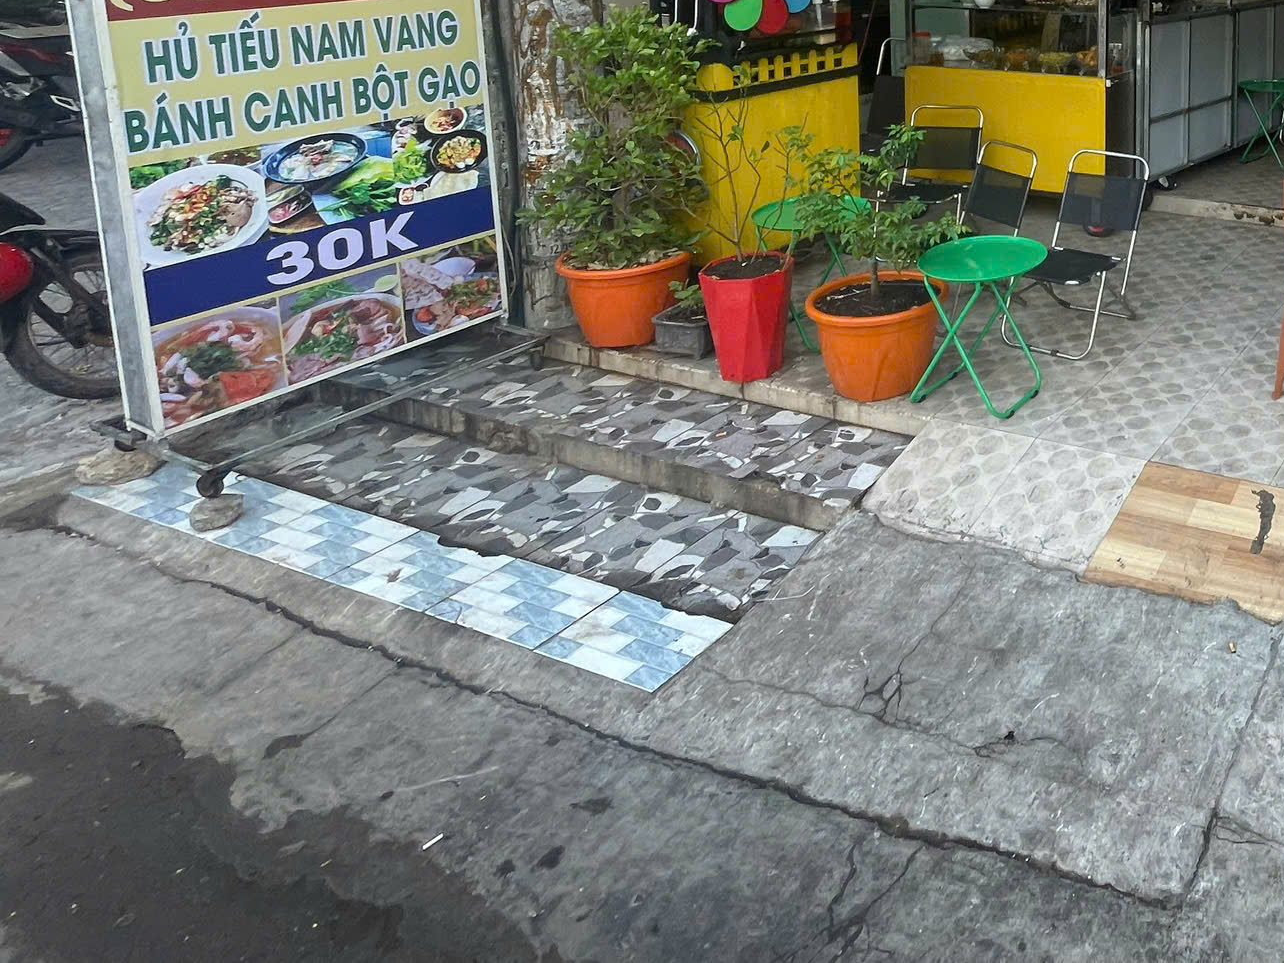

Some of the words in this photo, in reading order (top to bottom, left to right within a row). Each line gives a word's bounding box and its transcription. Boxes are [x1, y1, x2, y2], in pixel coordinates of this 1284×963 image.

[143, 21, 198, 84] HỦ
[209, 12, 280, 75] TIẾU
[292, 23, 366, 66] NAM
[374, 9, 459, 54] VANG
[124, 94, 231, 154] BÁNH
[244, 82, 344, 134] CANH
[354, 63, 410, 121] BỘT
[418, 61, 481, 109] GẠO
[265, 211, 419, 286] 30K
